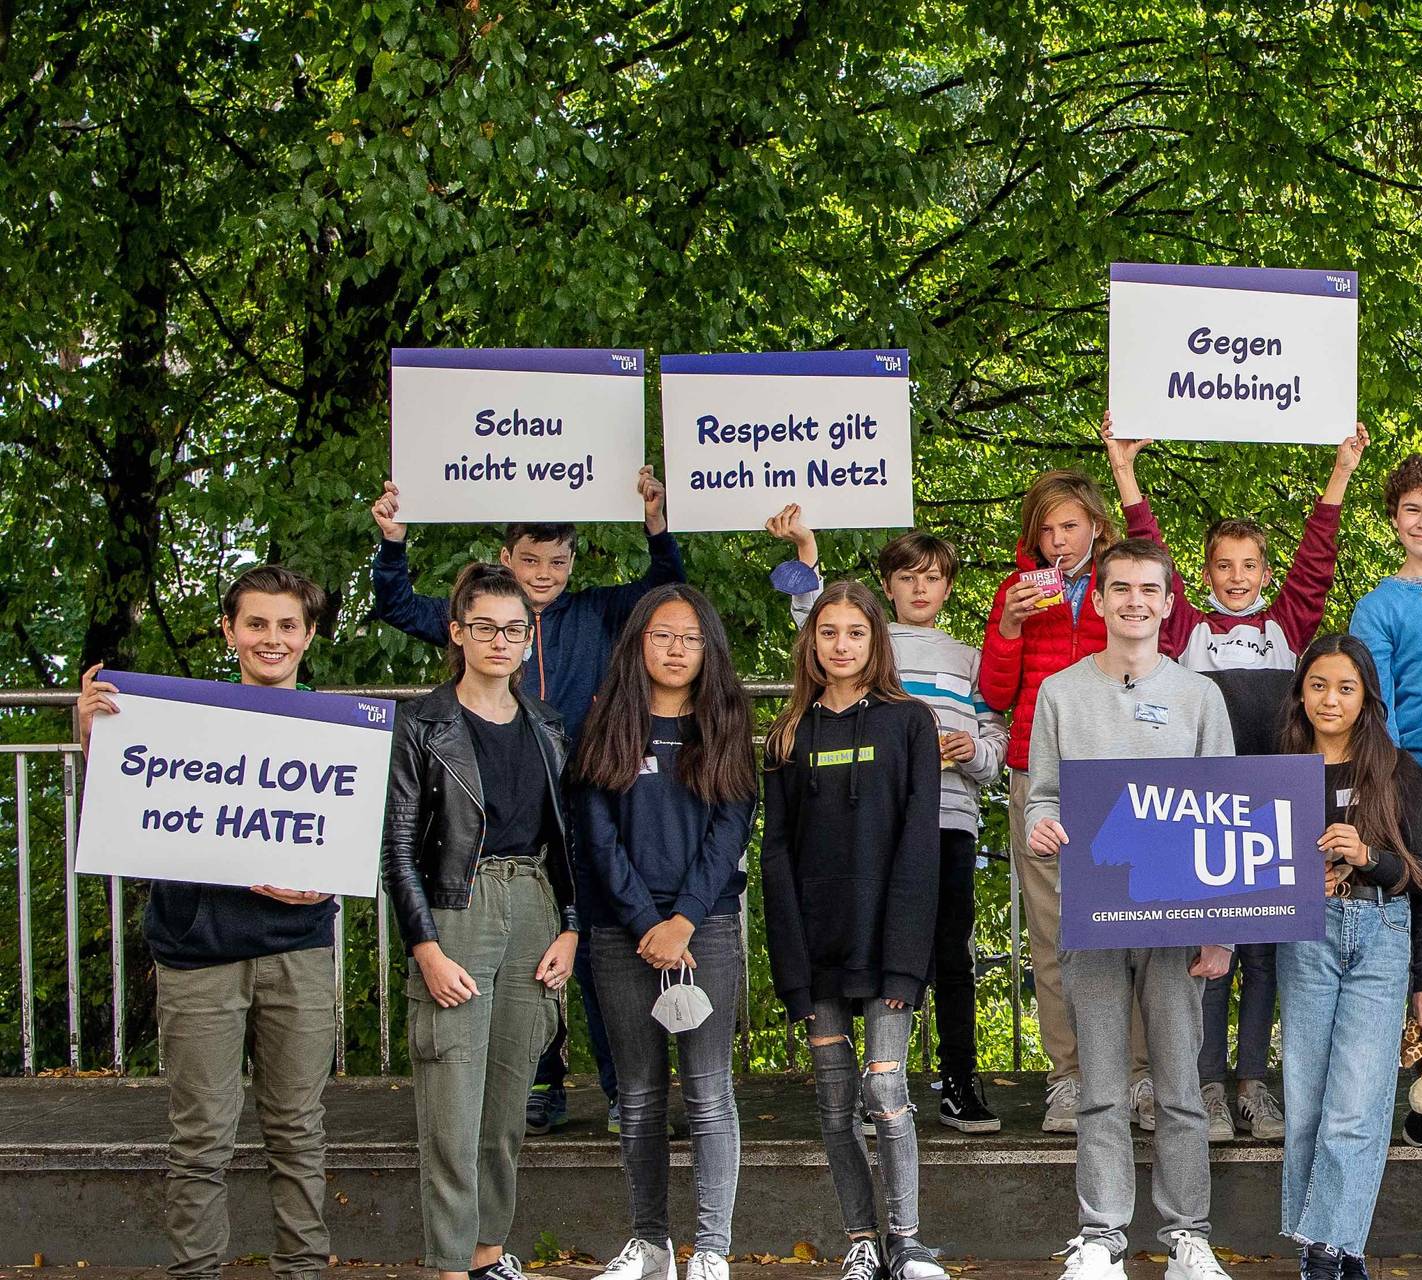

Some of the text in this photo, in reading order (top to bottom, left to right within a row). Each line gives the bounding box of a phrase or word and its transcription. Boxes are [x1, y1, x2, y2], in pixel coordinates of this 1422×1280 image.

[1188, 327, 1282, 364] Gegen
[1168, 372, 1301, 411] Mobbing!
[475, 409, 563, 437] Schau
[697, 413, 878, 453] Respekt gilt
[445, 453, 594, 490] nicht weg!
[690, 459, 888, 490] auch im Netz!
[1022, 570, 1056, 582] DURST
[358, 702, 380, 713] WAKE
[368, 708, 386, 724] UP!
[121, 745, 358, 797] Spread LOVE
[1128, 782, 1252, 827] WAKE
[142, 805, 326, 846] not HATE!
[1193, 799, 1296, 886] UP!
[1092, 905, 1296, 922] GEMEINSAM GEGEN CYBERMOBBING
